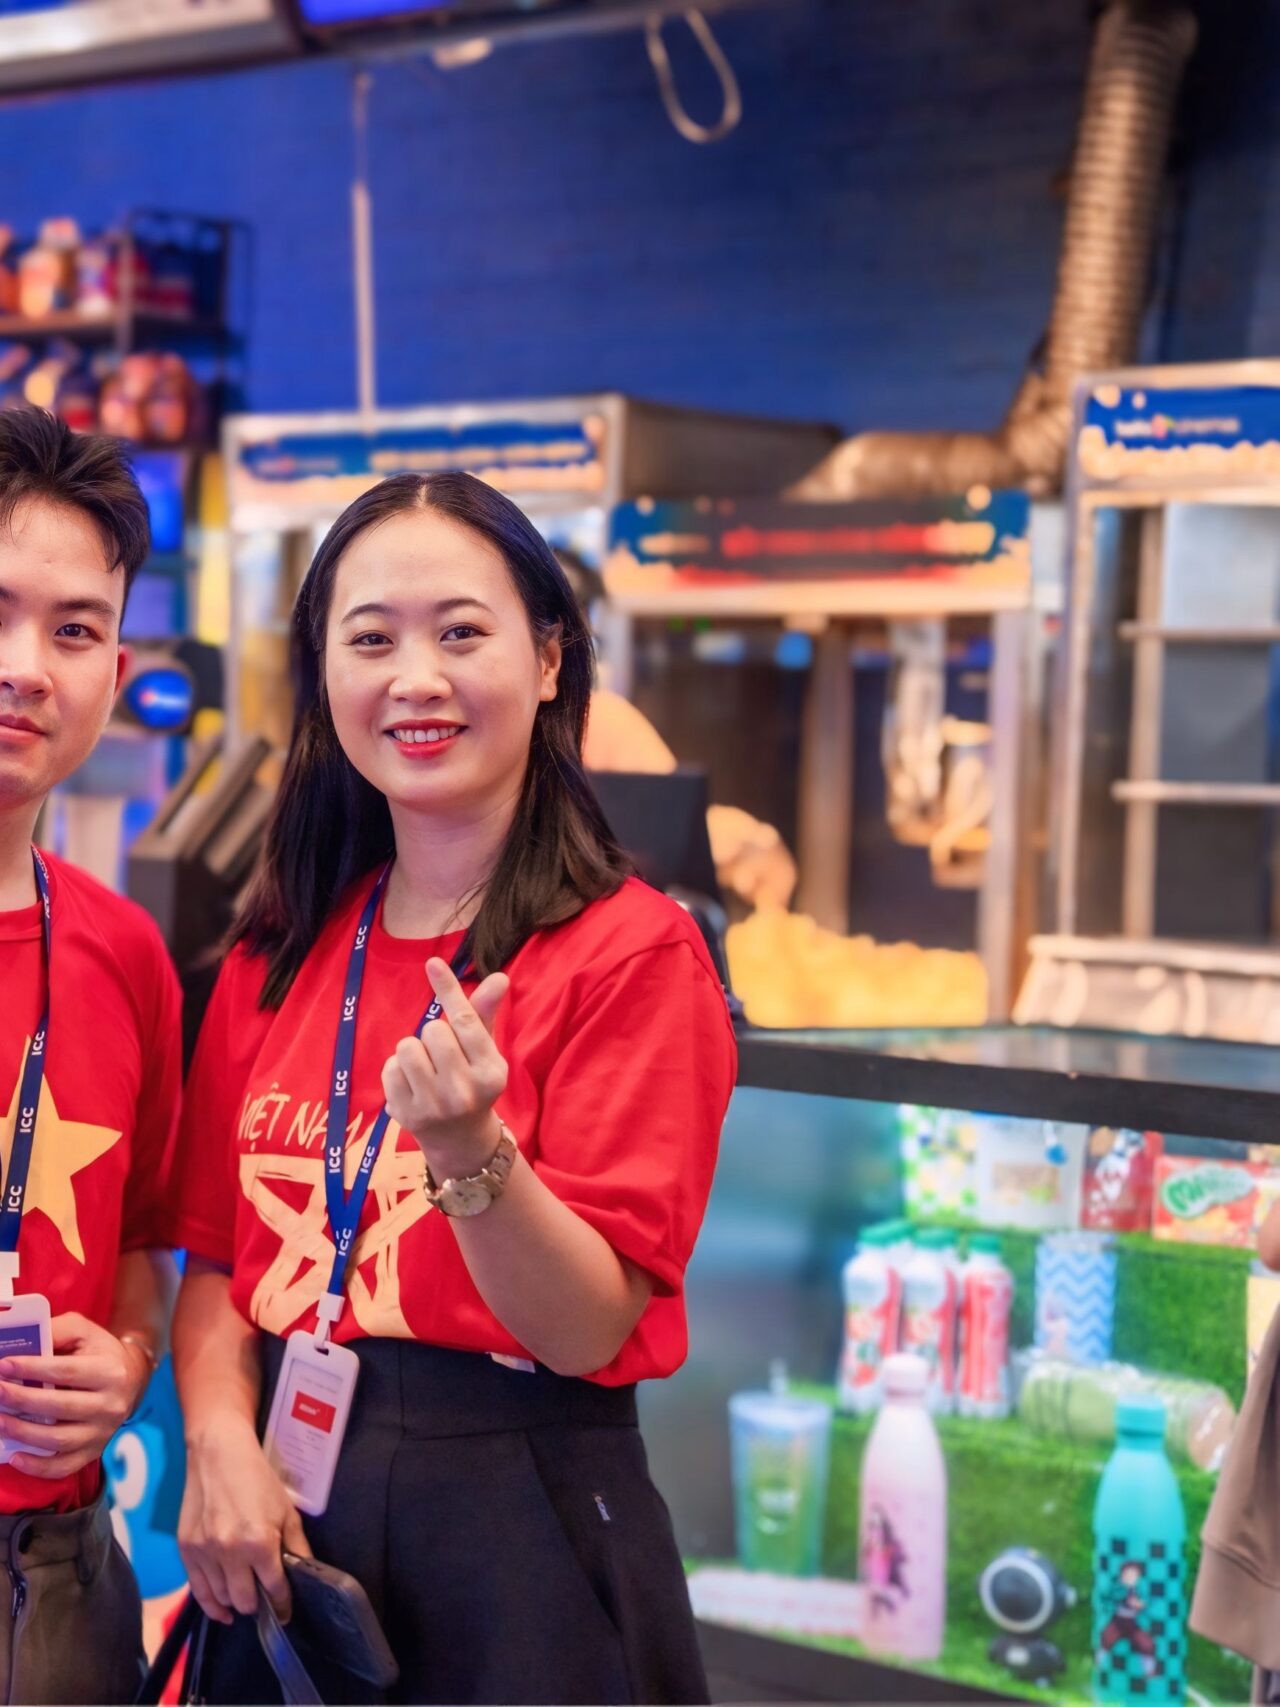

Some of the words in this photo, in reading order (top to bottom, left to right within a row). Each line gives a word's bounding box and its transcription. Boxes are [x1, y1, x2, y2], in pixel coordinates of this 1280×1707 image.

[355, 925, 368, 951] ICC
[343, 995, 356, 1022] ICC
[31, 1030, 45, 1056] ICC
[335, 1070, 348, 1096] ICC
[20, 1107, 34, 1133] ICC
[329, 1146, 341, 1174] ICC
[360, 1146, 375, 1174] ICC
[7, 1185, 22, 1213] ICC
[338, 1228, 352, 1257] ICC
